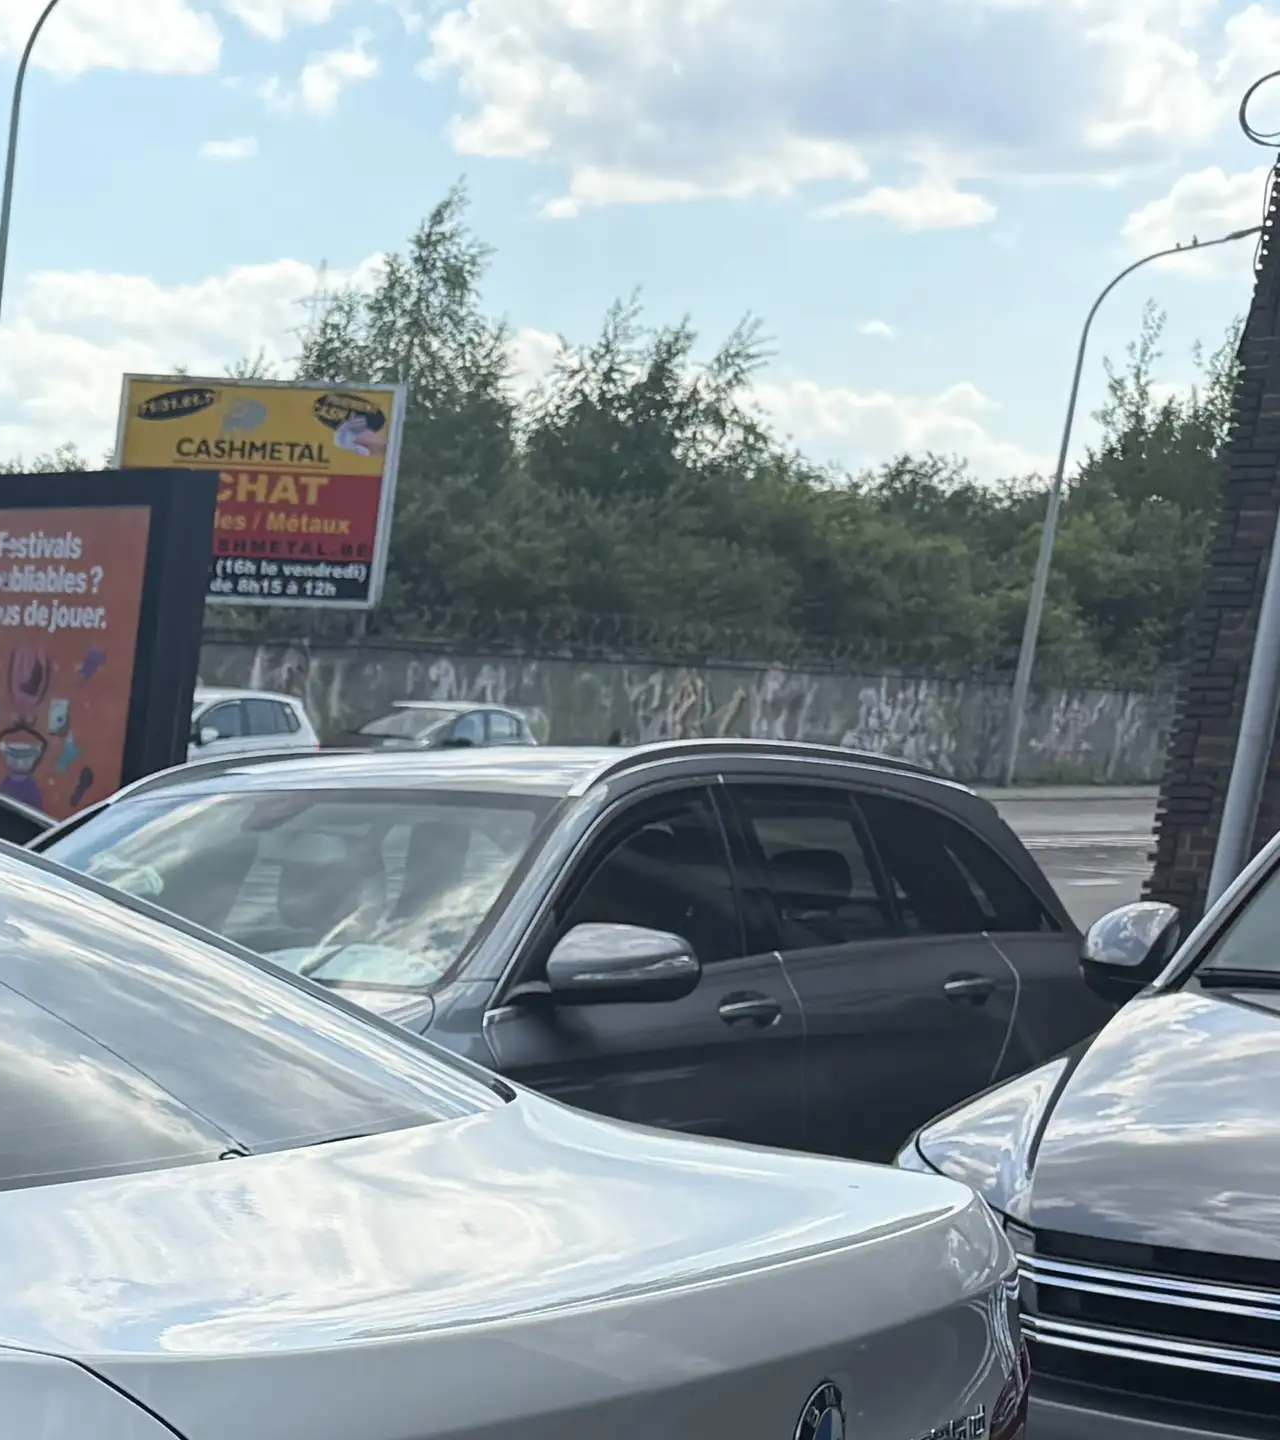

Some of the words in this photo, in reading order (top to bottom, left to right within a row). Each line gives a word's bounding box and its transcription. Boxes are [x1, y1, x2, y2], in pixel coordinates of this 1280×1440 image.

[176, 437, 330, 464] CASHMETAL
[90, 565, 104, 594] ?
[260, 559, 278, 577] le
[282, 562, 368, 584] vendredi)
[209, 577, 233, 594] de
[303, 580, 337, 597] 12h
[23, 600, 49, 628] de
[48, 600, 108, 634] jouer.
